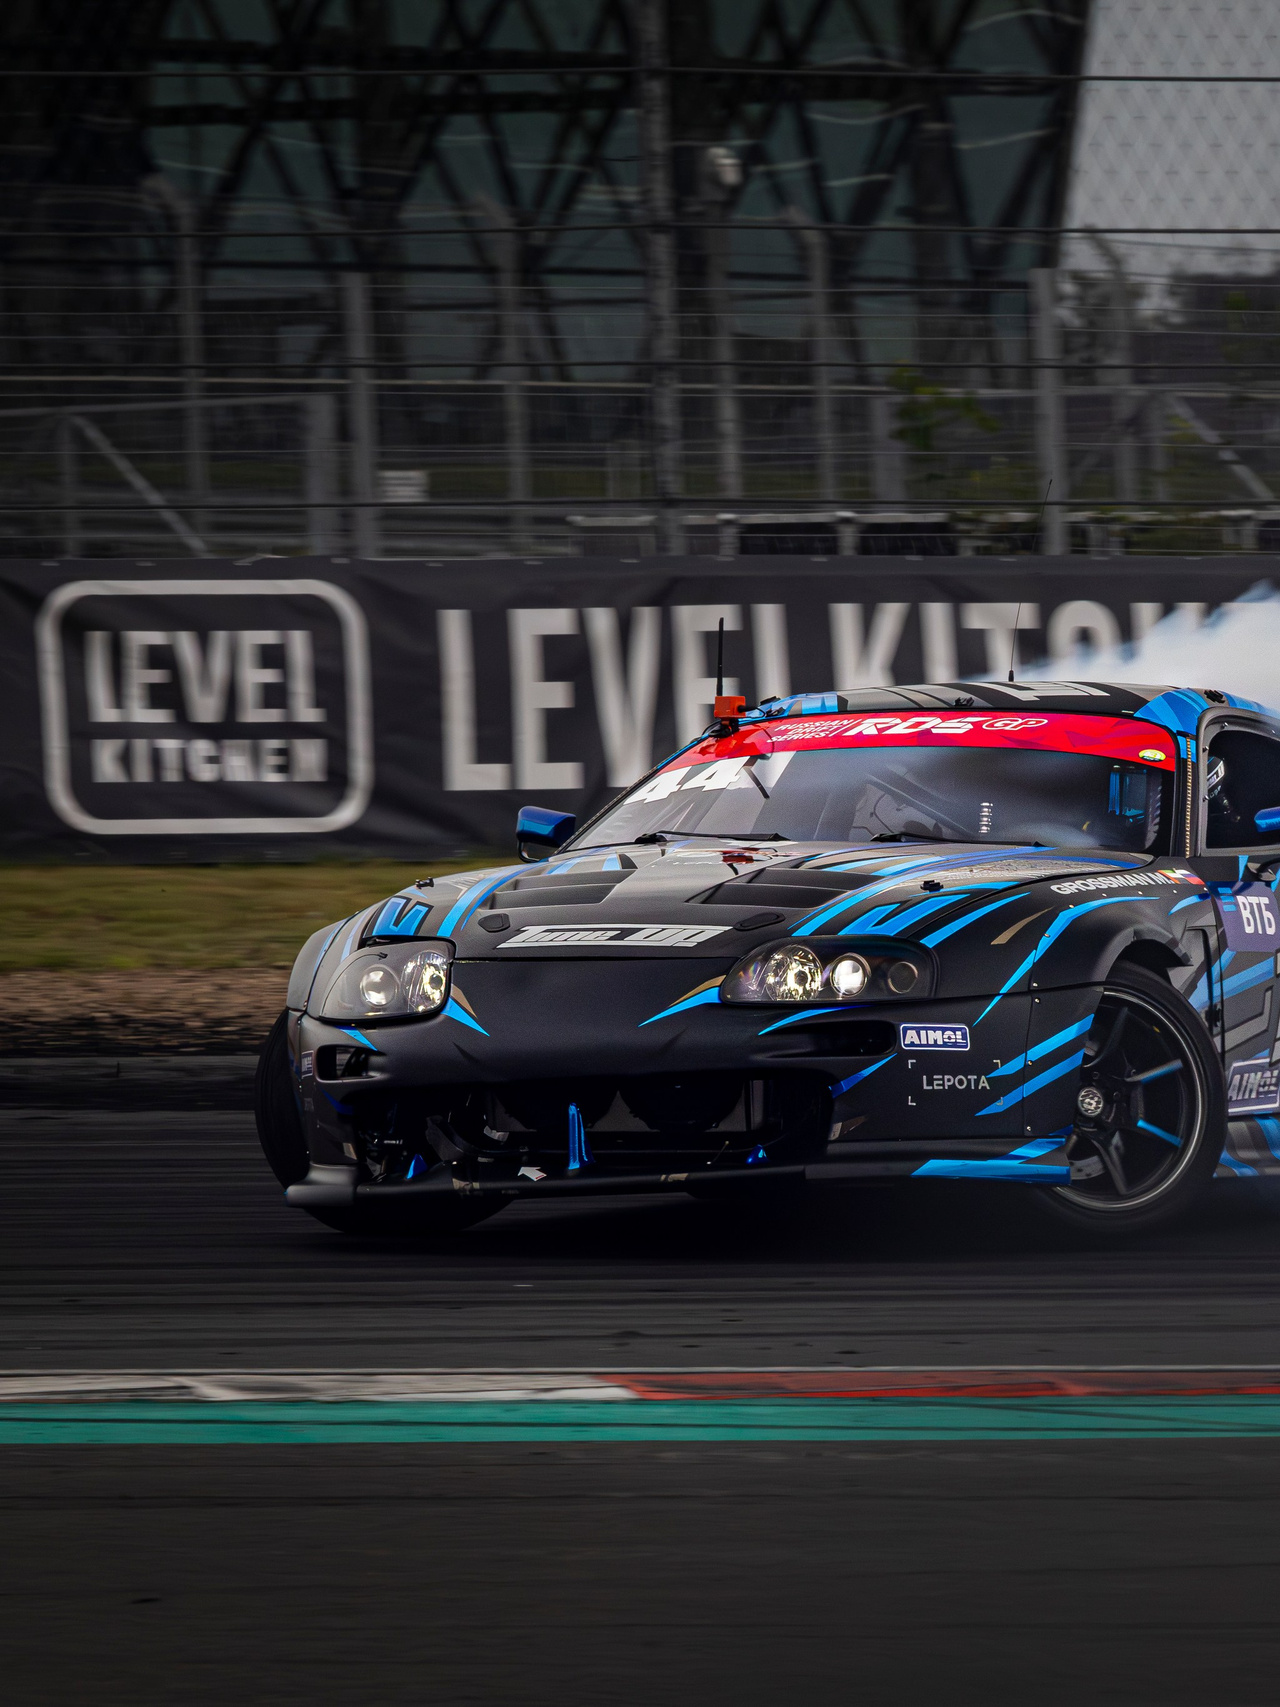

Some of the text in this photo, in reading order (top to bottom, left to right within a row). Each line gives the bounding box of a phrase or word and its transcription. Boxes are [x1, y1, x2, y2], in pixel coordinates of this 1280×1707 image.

[84, 630, 327, 723] LEVEL
[774, 719, 854, 732] RUSSIAN
[787, 725, 843, 735] DRIFT
[842, 717, 1048, 736] RDS GP
[766, 731, 830, 743] SERIES
[90, 738, 328, 783] KITCHEN
[623, 756, 750, 805] 44
[1050, 873, 1156, 895] GROSSMAN
[1236, 895, 1277, 936] ВТБ
[904, 1029, 967, 1046] AIMOL
[922, 1075, 991, 1090] LEPOTA
[1228, 1070, 1279, 1100] AIMOL
